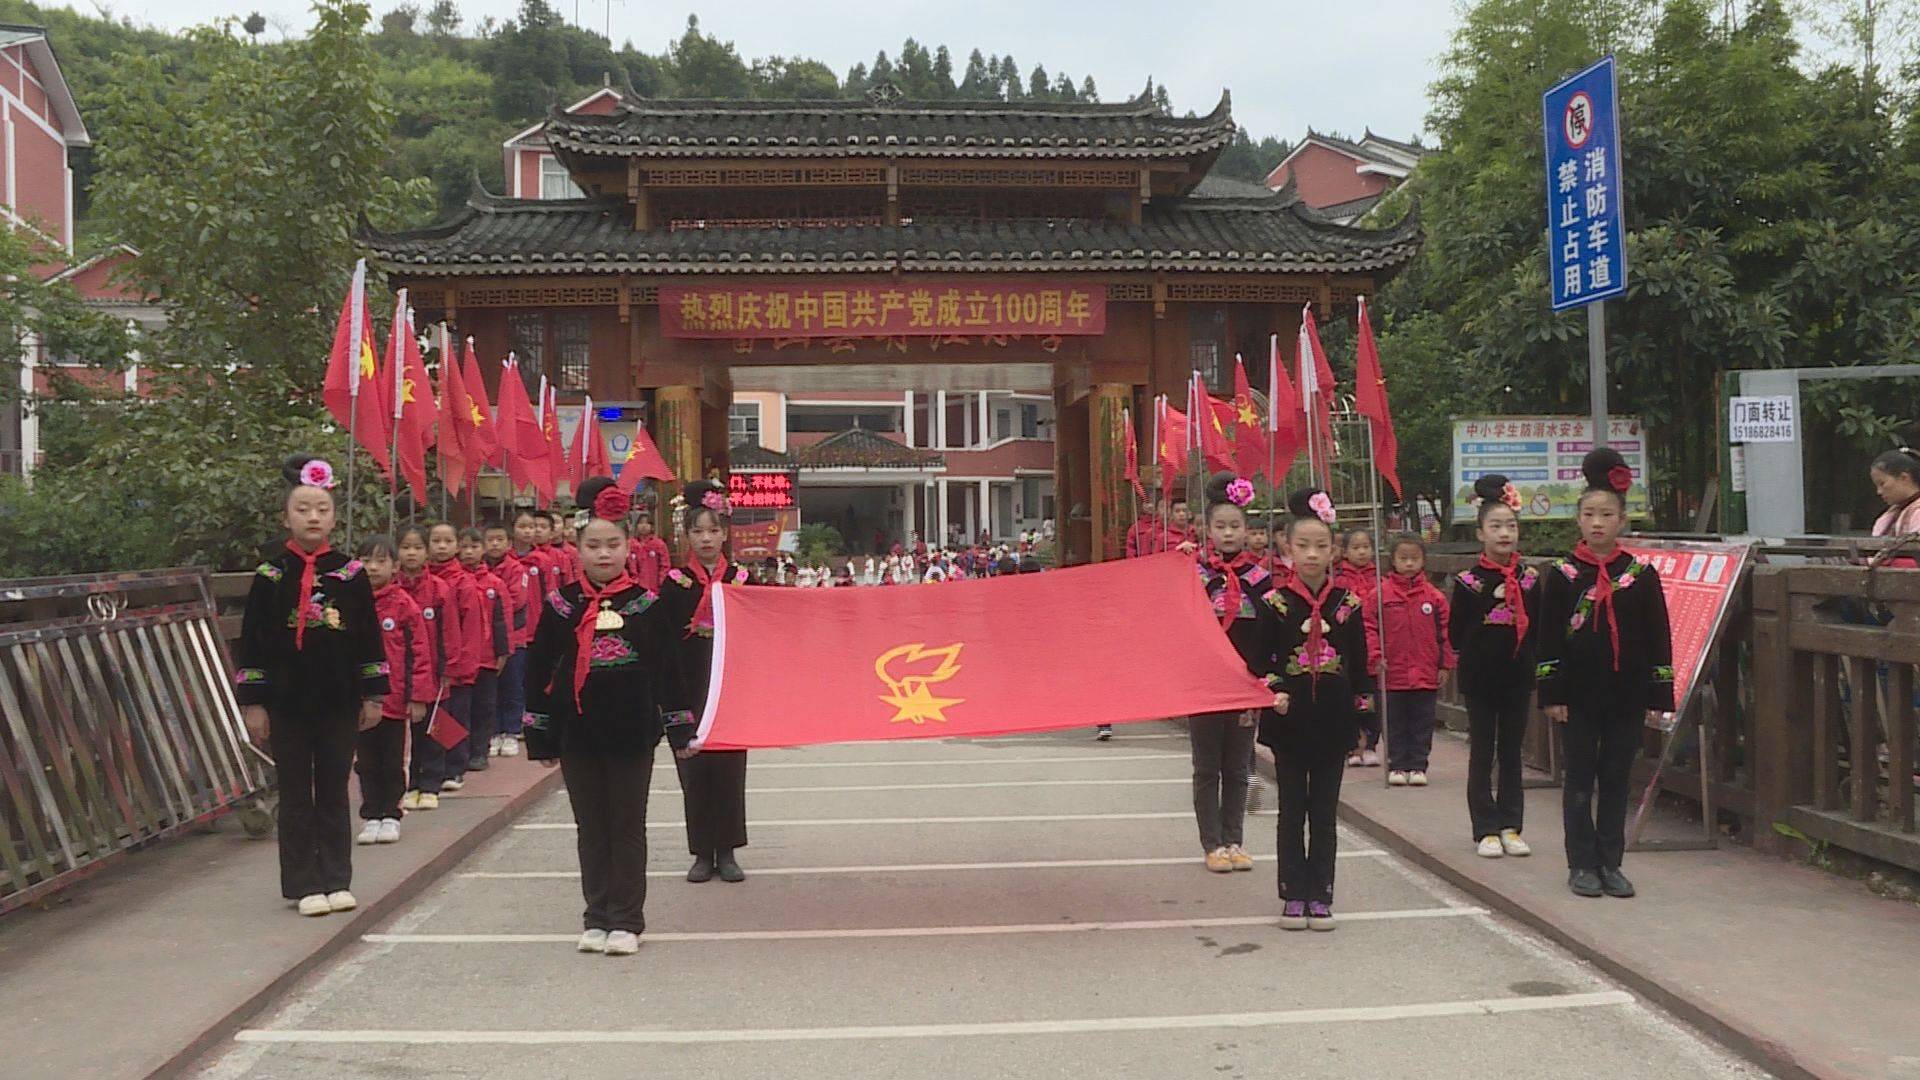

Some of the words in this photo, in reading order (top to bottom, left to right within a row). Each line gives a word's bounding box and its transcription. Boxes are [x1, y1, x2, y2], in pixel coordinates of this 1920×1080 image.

[1557, 158, 1581, 298] 禁止占用
[1584, 147, 1611, 290] 消防车道
[680, 289, 1092, 331] 热烈庆祝中国共产党成立100周年
[1734, 401, 1792, 423] 门面转让
